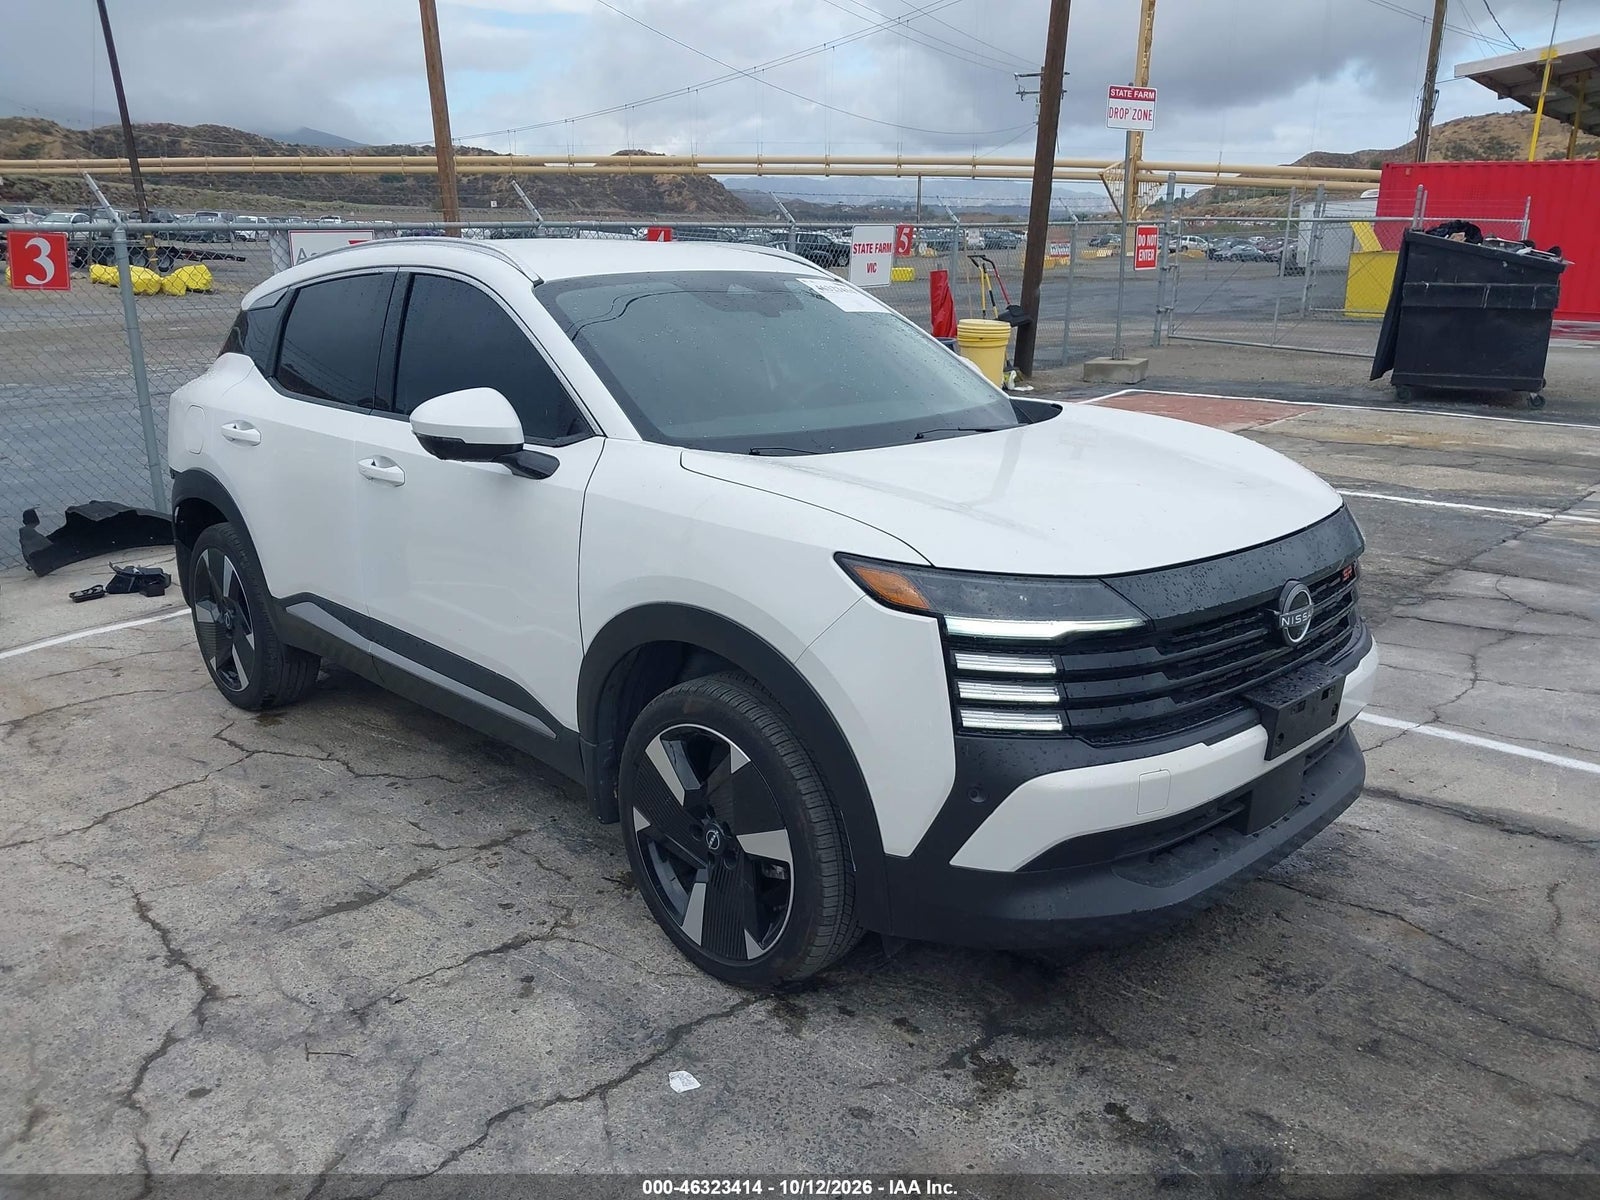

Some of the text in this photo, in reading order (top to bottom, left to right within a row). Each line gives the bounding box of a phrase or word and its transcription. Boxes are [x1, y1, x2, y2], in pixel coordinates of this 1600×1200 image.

[1110, 89, 1155, 99] STATE FARM
[1109, 106, 1153, 121] DROP ZONE
[898, 227, 911, 253] 5
[1138, 234, 1157, 247] DO NOT
[853, 242, 893, 254] STATE FARM
[25, 237, 55, 285] 3
[1138, 249, 1155, 261] ENTER
[866, 262, 878, 274] VIC
